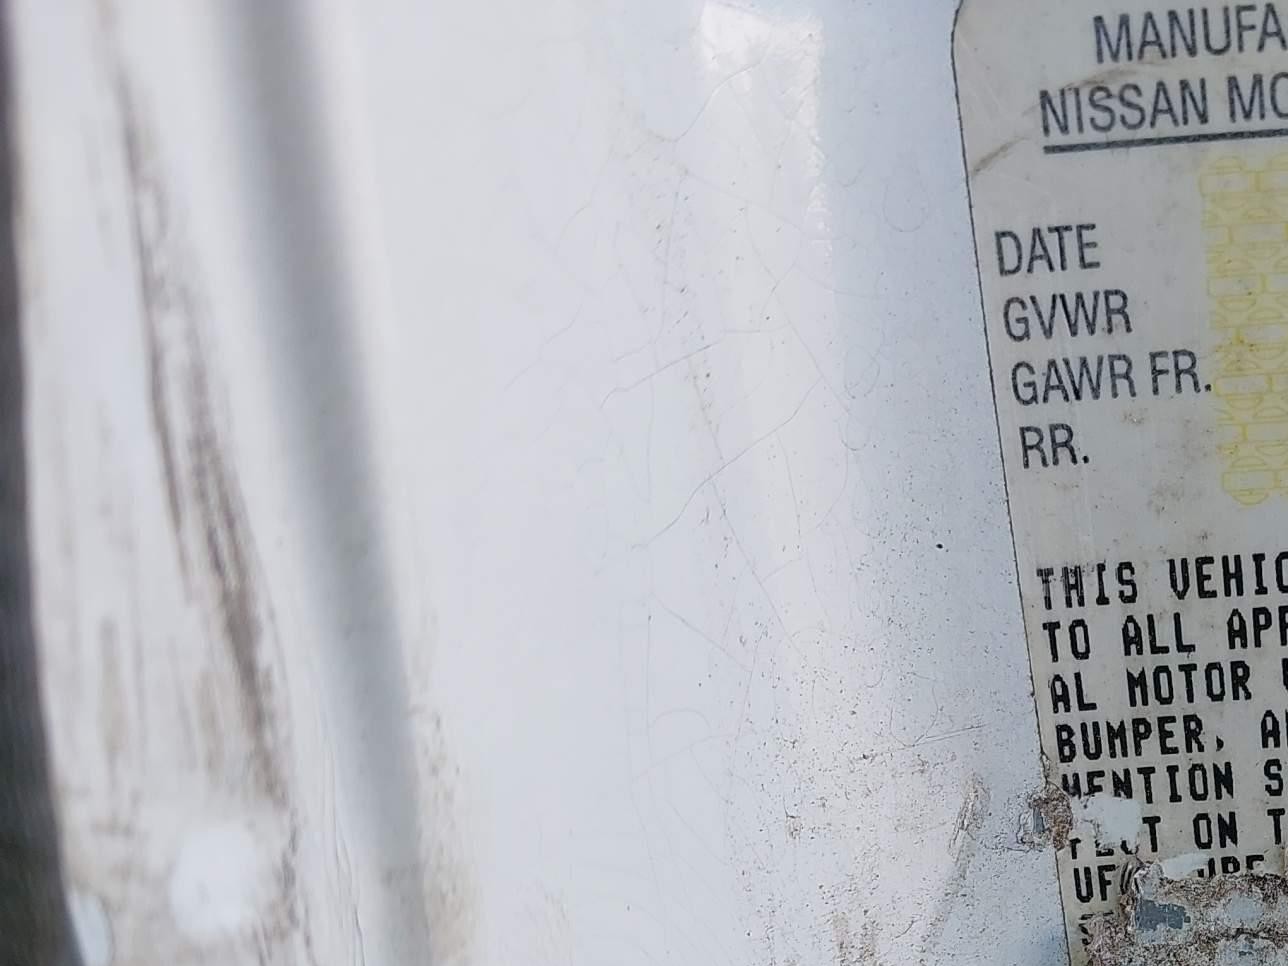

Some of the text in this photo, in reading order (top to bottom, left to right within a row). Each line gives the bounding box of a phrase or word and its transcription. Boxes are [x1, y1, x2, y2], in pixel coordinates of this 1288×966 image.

[1040, 78, 1210, 137] NISSAN
[995, 223, 1101, 277] DATE
[1003, 288, 1132, 343] GVWR
[1010, 353, 1136, 406] GAWR
[1150, 349, 1212, 395] FR.
[1020, 422, 1090, 469] RR.
[1037, 560, 1138, 611] THIS
[1043, 618, 1092, 663] TO
[1121, 611, 1196, 657] ALL
[1050, 672, 1098, 714] AL
[1126, 660, 1252, 708] MOTOR
[1056, 714, 1224, 763] BUMPER,
[1192, 811, 1239, 851] ON
